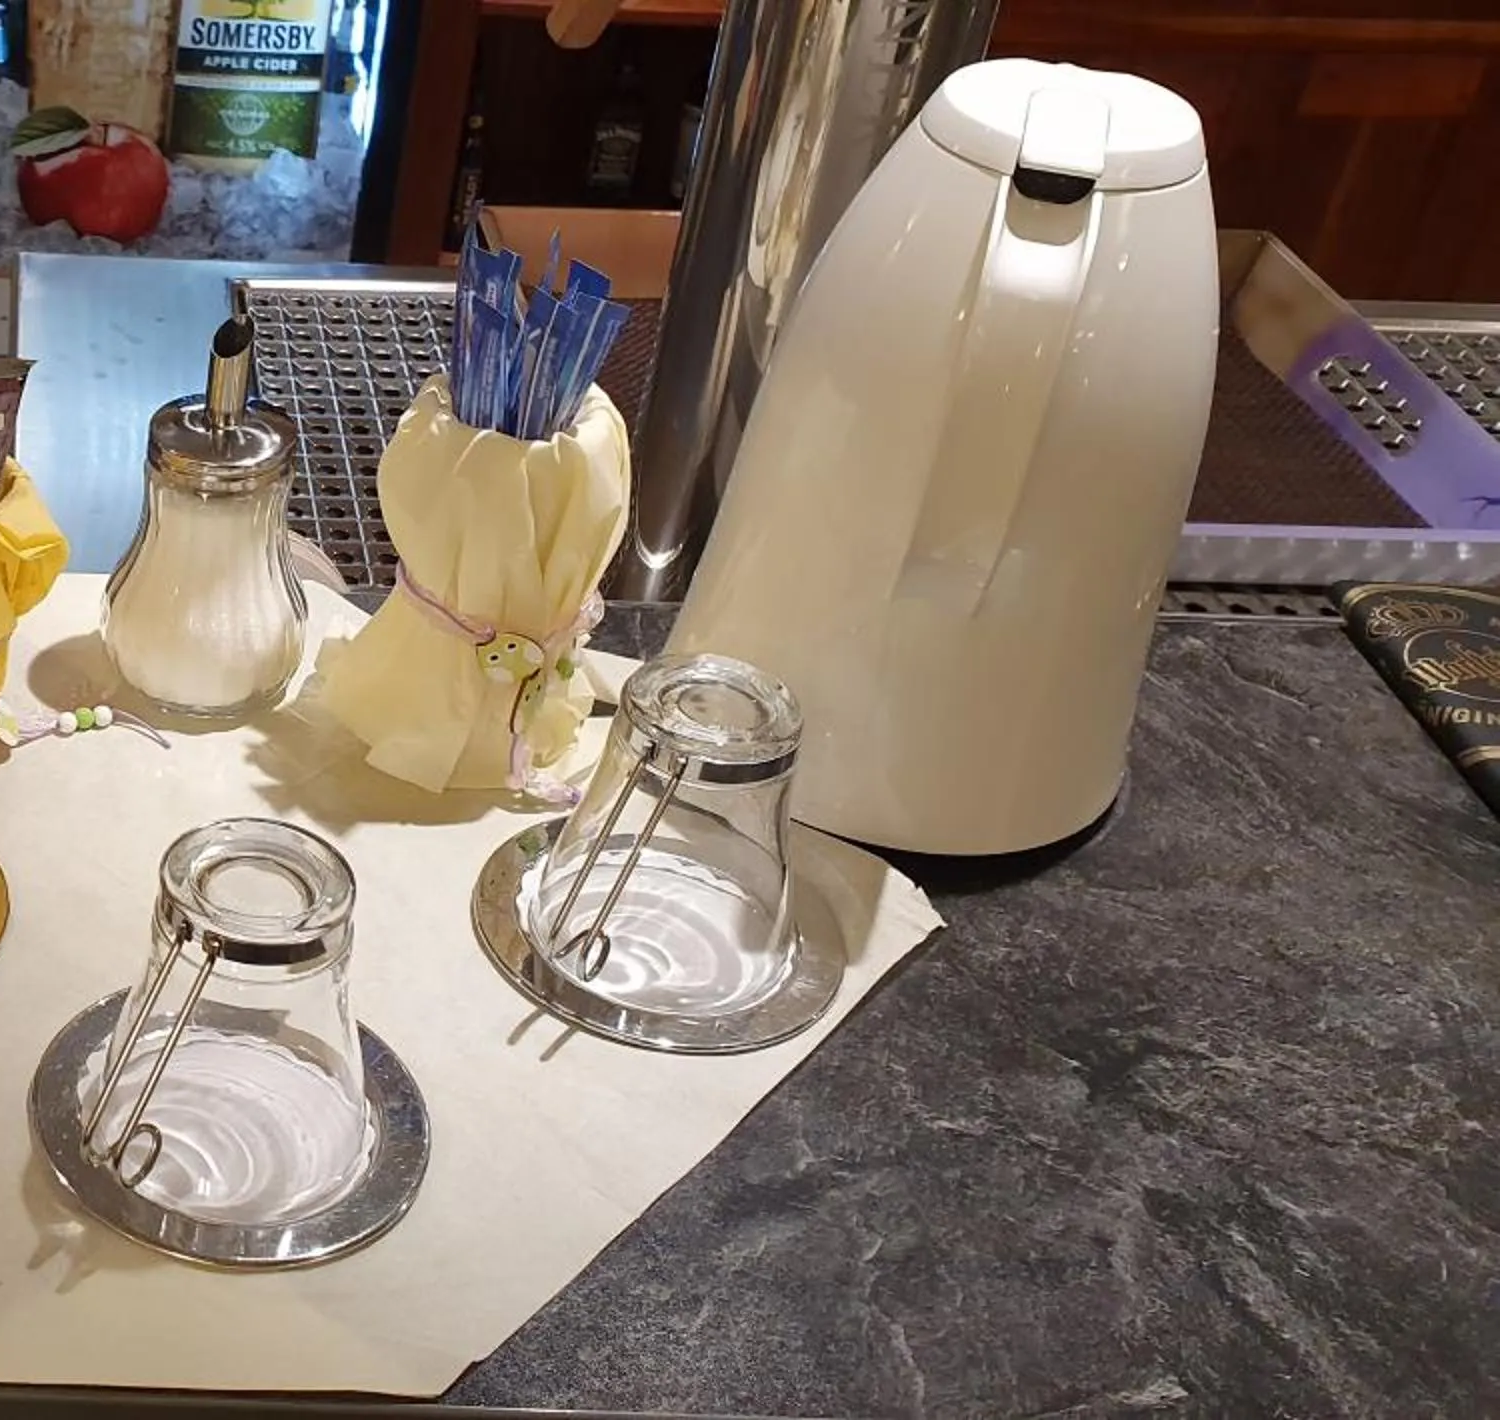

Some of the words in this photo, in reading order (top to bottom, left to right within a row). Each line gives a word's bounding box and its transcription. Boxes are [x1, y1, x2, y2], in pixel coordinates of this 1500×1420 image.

[191, 18, 316, 50] SOMERSBY
[204, 56, 249, 69] APPLE
[253, 57, 298, 72] CIDER
